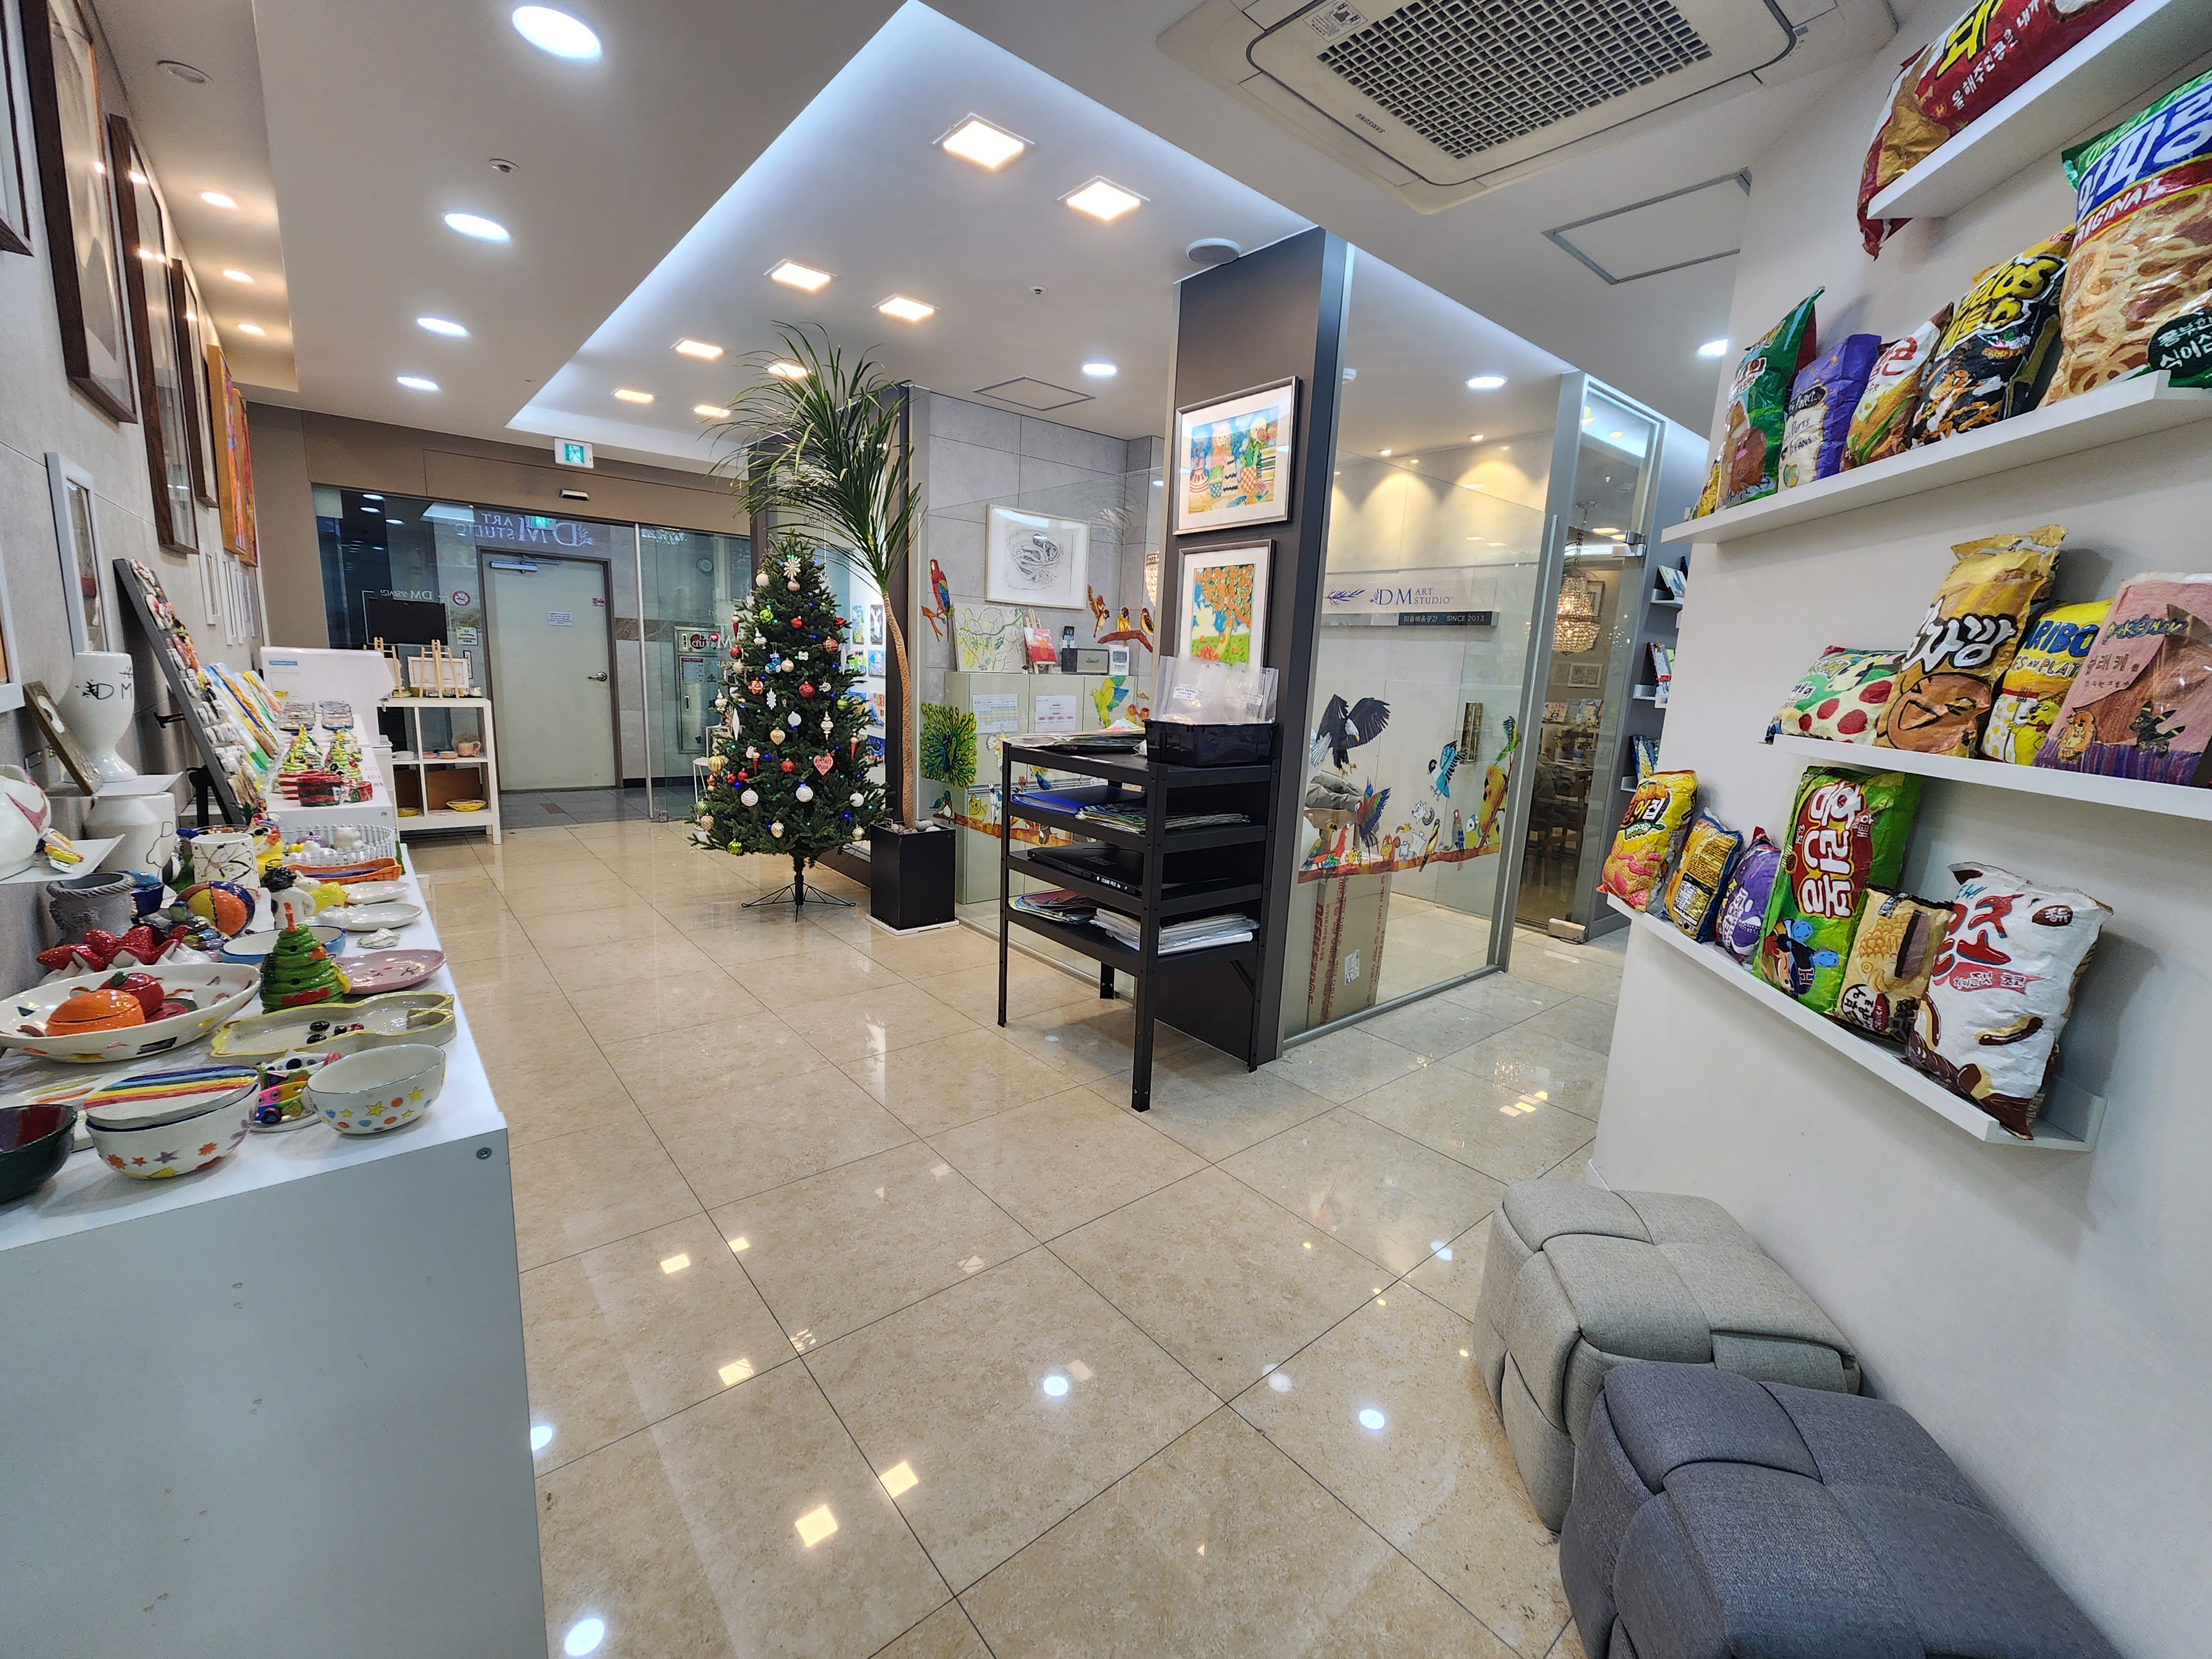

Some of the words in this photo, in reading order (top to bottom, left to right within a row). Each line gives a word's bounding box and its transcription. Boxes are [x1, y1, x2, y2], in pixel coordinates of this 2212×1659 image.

[1355, 113, 1385, 133] SAMSUNG
[2074, 177, 2166, 245] RIGINAL
[1379, 588, 1412, 605] DM
[1414, 596, 1450, 604] STUDIO
[2024, 620, 2100, 658] ARIBO
[1802, 782, 1862, 917] 홈런볼
[2001, 973, 2026, 988] 초코
